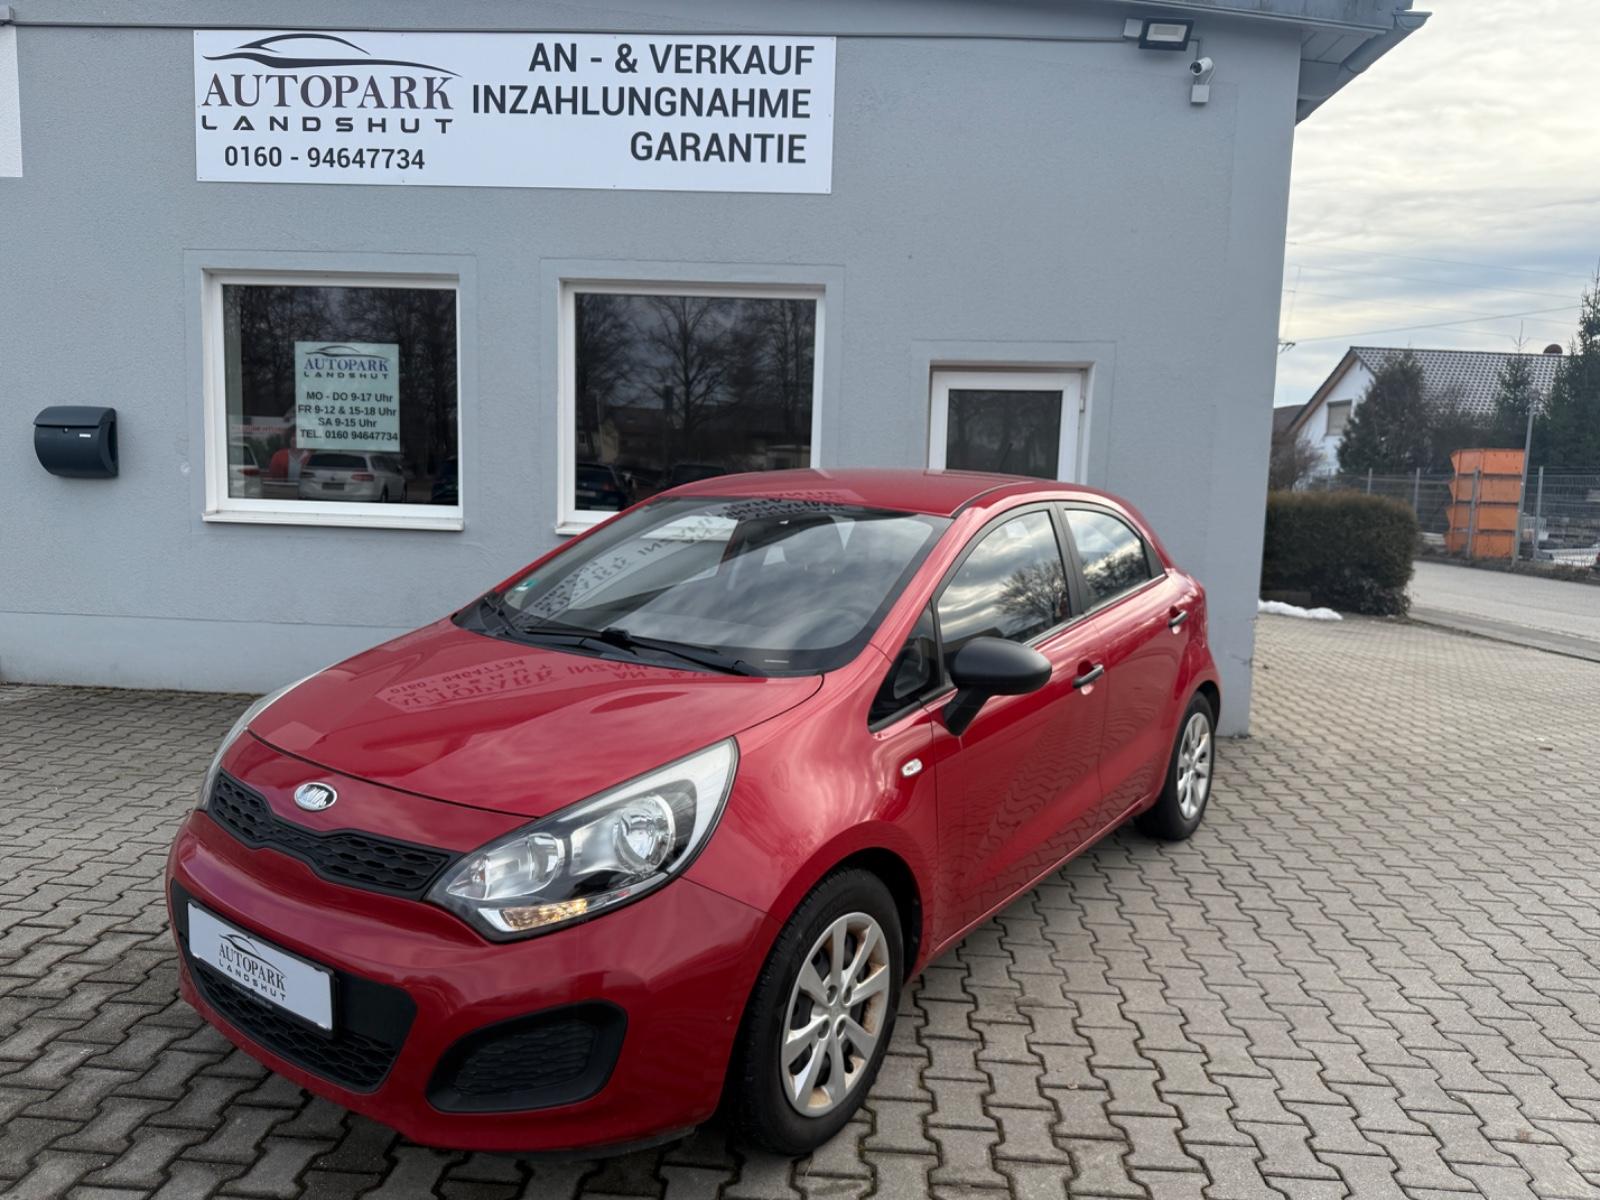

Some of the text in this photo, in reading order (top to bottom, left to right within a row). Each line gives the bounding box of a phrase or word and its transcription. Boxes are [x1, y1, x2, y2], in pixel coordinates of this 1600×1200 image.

[528, 42, 577, 73] AN
[614, 43, 638, 73] &
[649, 44, 815, 75] VERKAUF
[201, 73, 454, 110] AUTOPARK
[472, 84, 811, 119] INZAHLUNGNAHME
[201, 115, 454, 134] LANDSHUT
[224, 145, 282, 167] 0160
[307, 147, 425, 170] 94647734
[630, 131, 807, 164] GARANTIE
[304, 358, 388, 371] AUTOPARK
[304, 371, 388, 379] LANDSHUT
[306, 391, 323, 401] MO
[332, 391, 348, 401] DO
[351, 392, 372, 401] 9-17
[374, 393, 393, 403] Uhr
[297, 404, 397, 417] FR 9-12 & 15-18 Uhr
[318, 417, 378, 428] SA 9-15 Uhr
[325, 430, 349, 440] 0160
[351, 430, 398, 441] 94647734
[218, 943, 287, 992] AUTOPARK
[218, 958, 286, 1001] LANDSHUT
